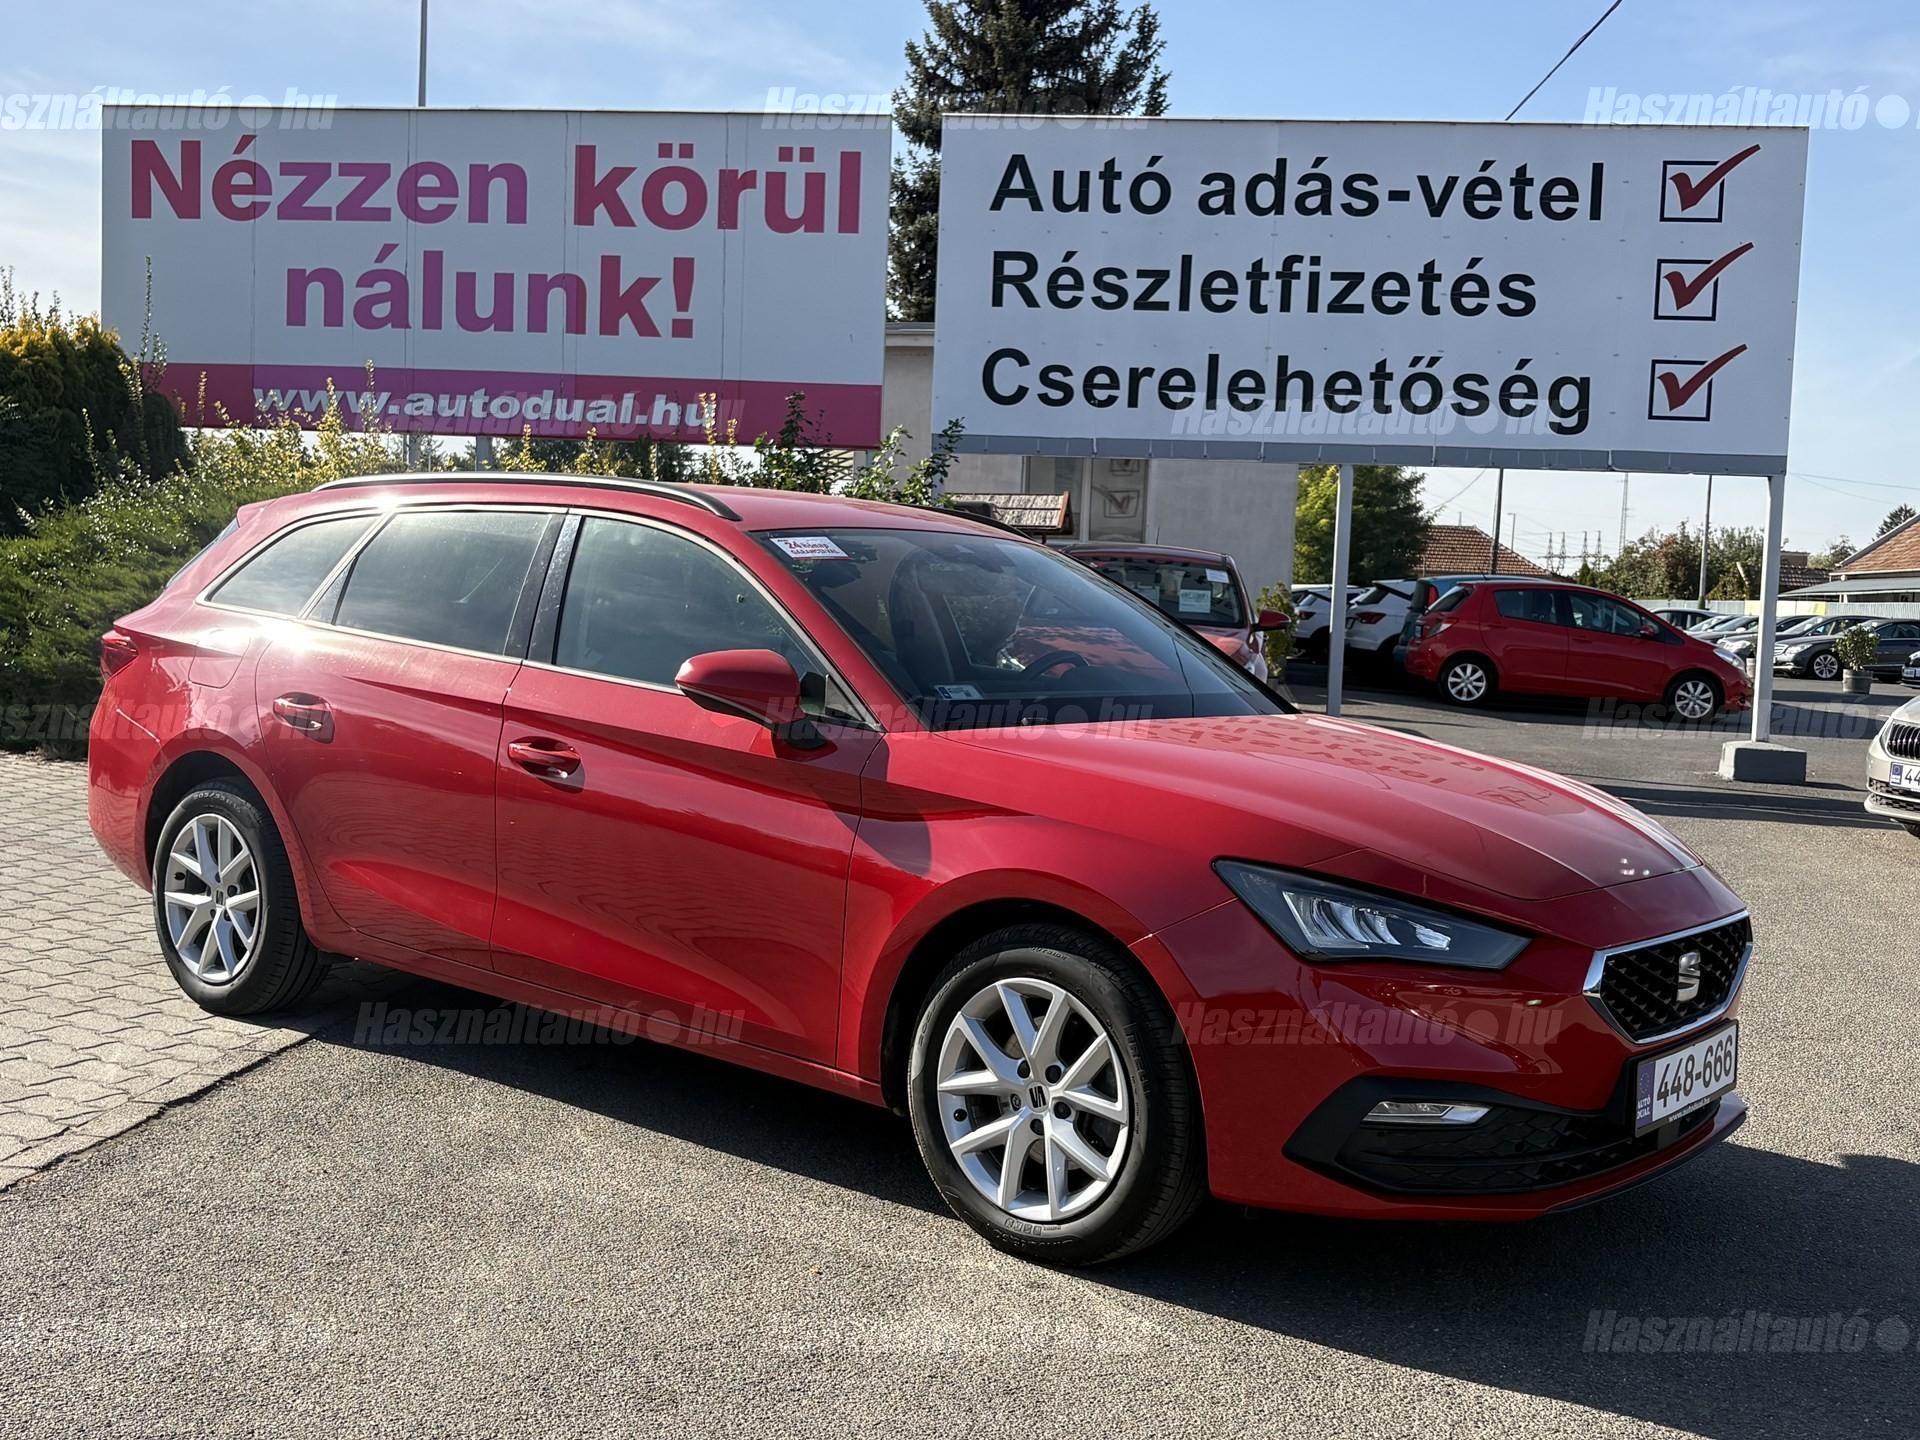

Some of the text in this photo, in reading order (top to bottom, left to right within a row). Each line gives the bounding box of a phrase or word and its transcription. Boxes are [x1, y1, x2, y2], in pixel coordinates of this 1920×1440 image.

[132, 136, 861, 234] Nézzen körül
[990, 153, 1605, 221] Autó adás-vétel
[286, 243, 695, 338] nálunk!
[992, 251, 1537, 317] Részletfizetés
[253, 386, 716, 428] www.autodual.hu
[982, 347, 1591, 436] Cserelehetőség
[1656, 1034, 1734, 1108] 448-666
